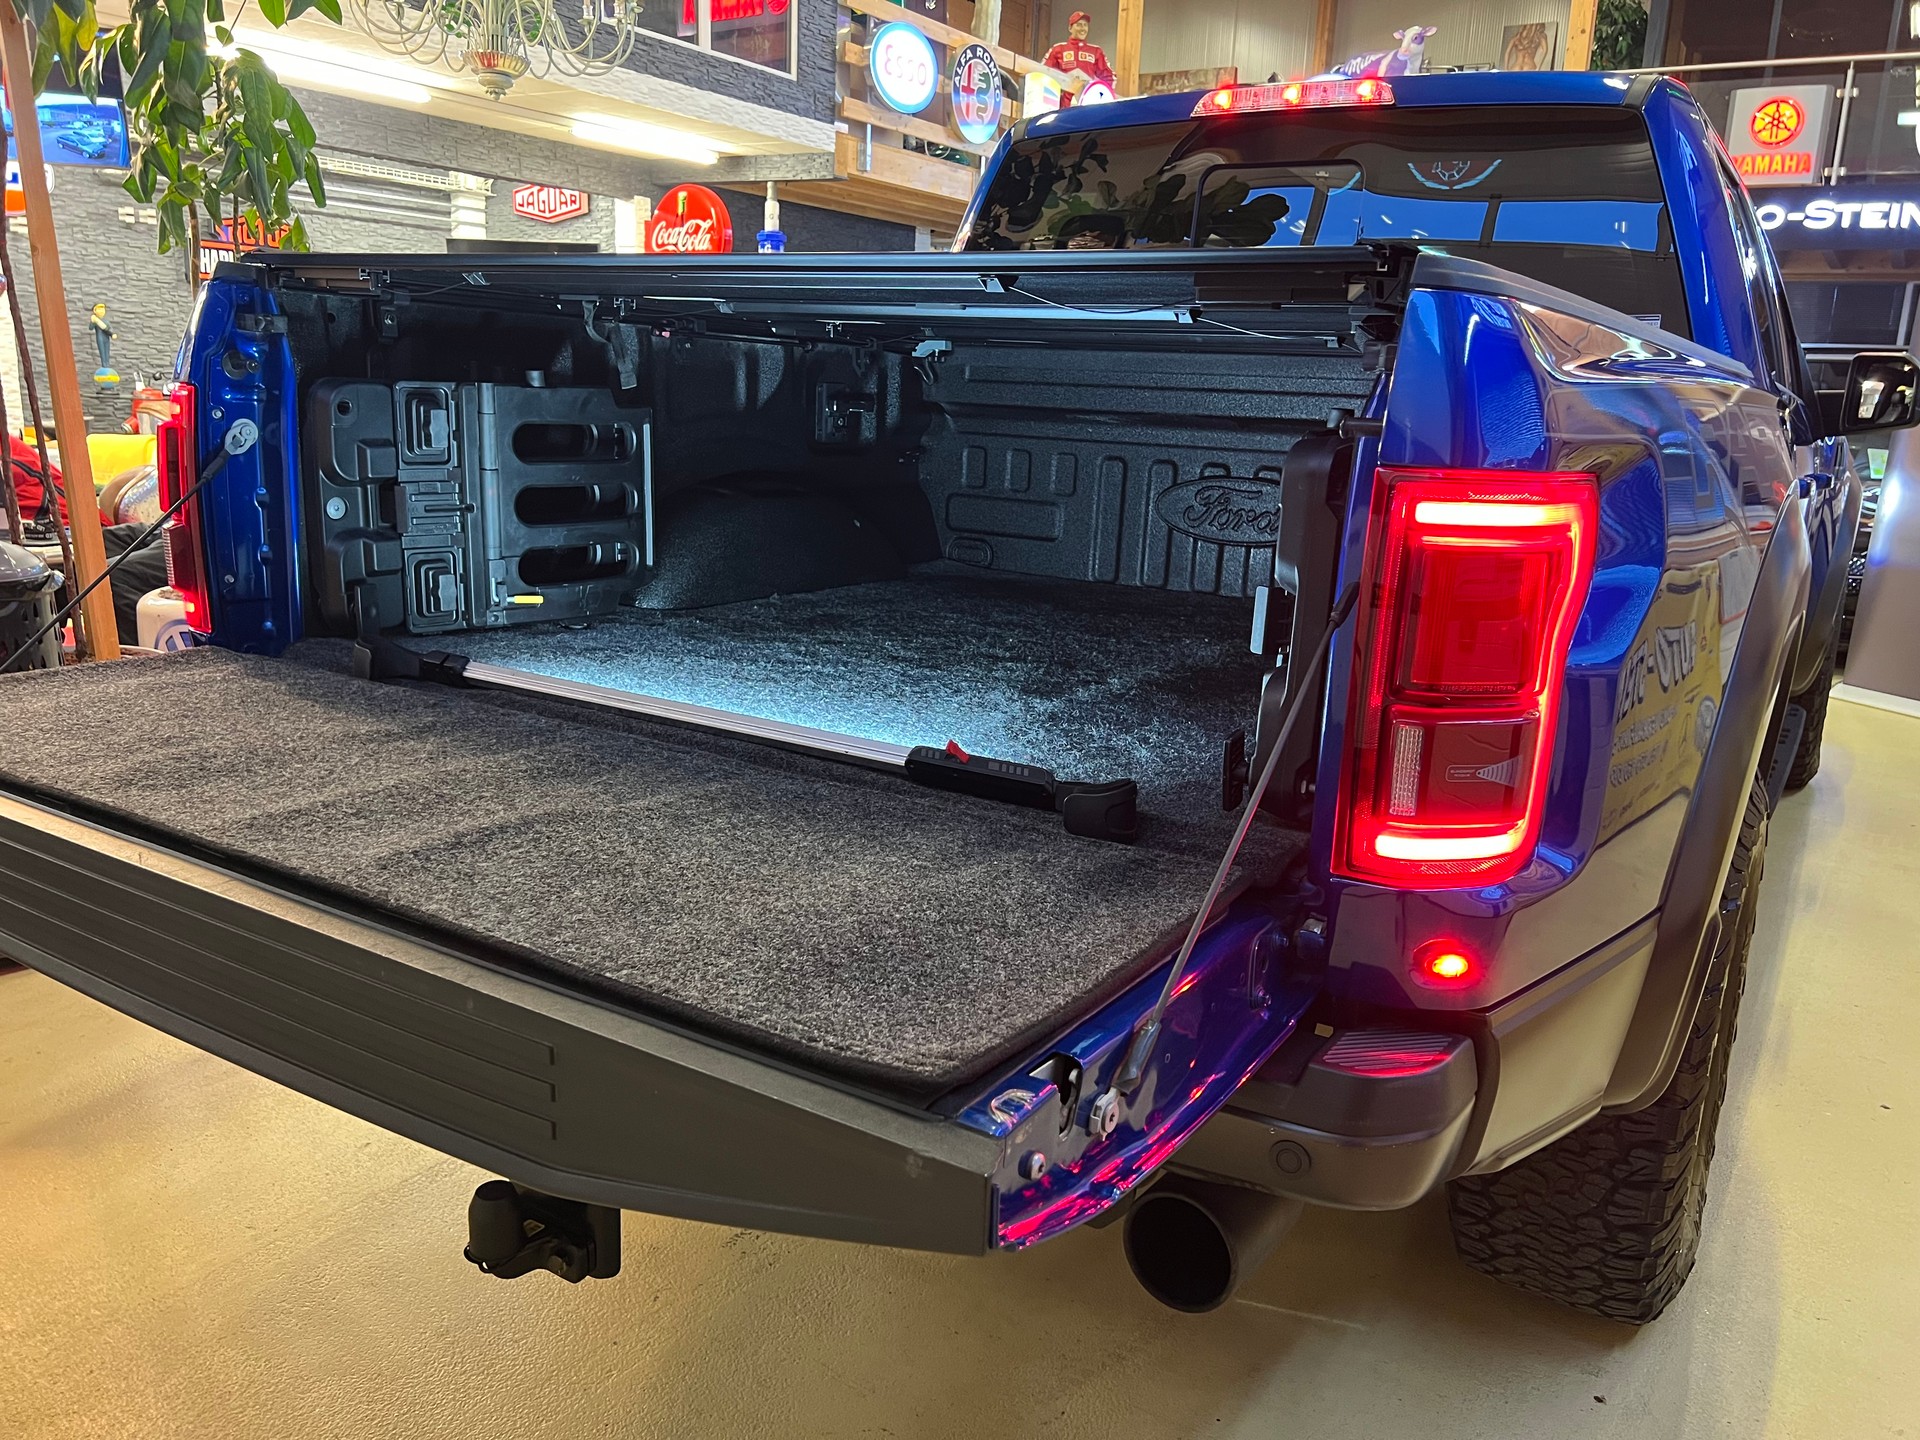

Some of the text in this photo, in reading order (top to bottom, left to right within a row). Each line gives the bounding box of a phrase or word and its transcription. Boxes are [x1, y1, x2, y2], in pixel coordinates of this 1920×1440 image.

[954, 47, 1001, 102] ALFA ROMEO
[1732, 152, 1813, 177] YAMAHA
[518, 187, 577, 214] JAGUAR
[1754, 200, 1920, 231] O-STEIN
